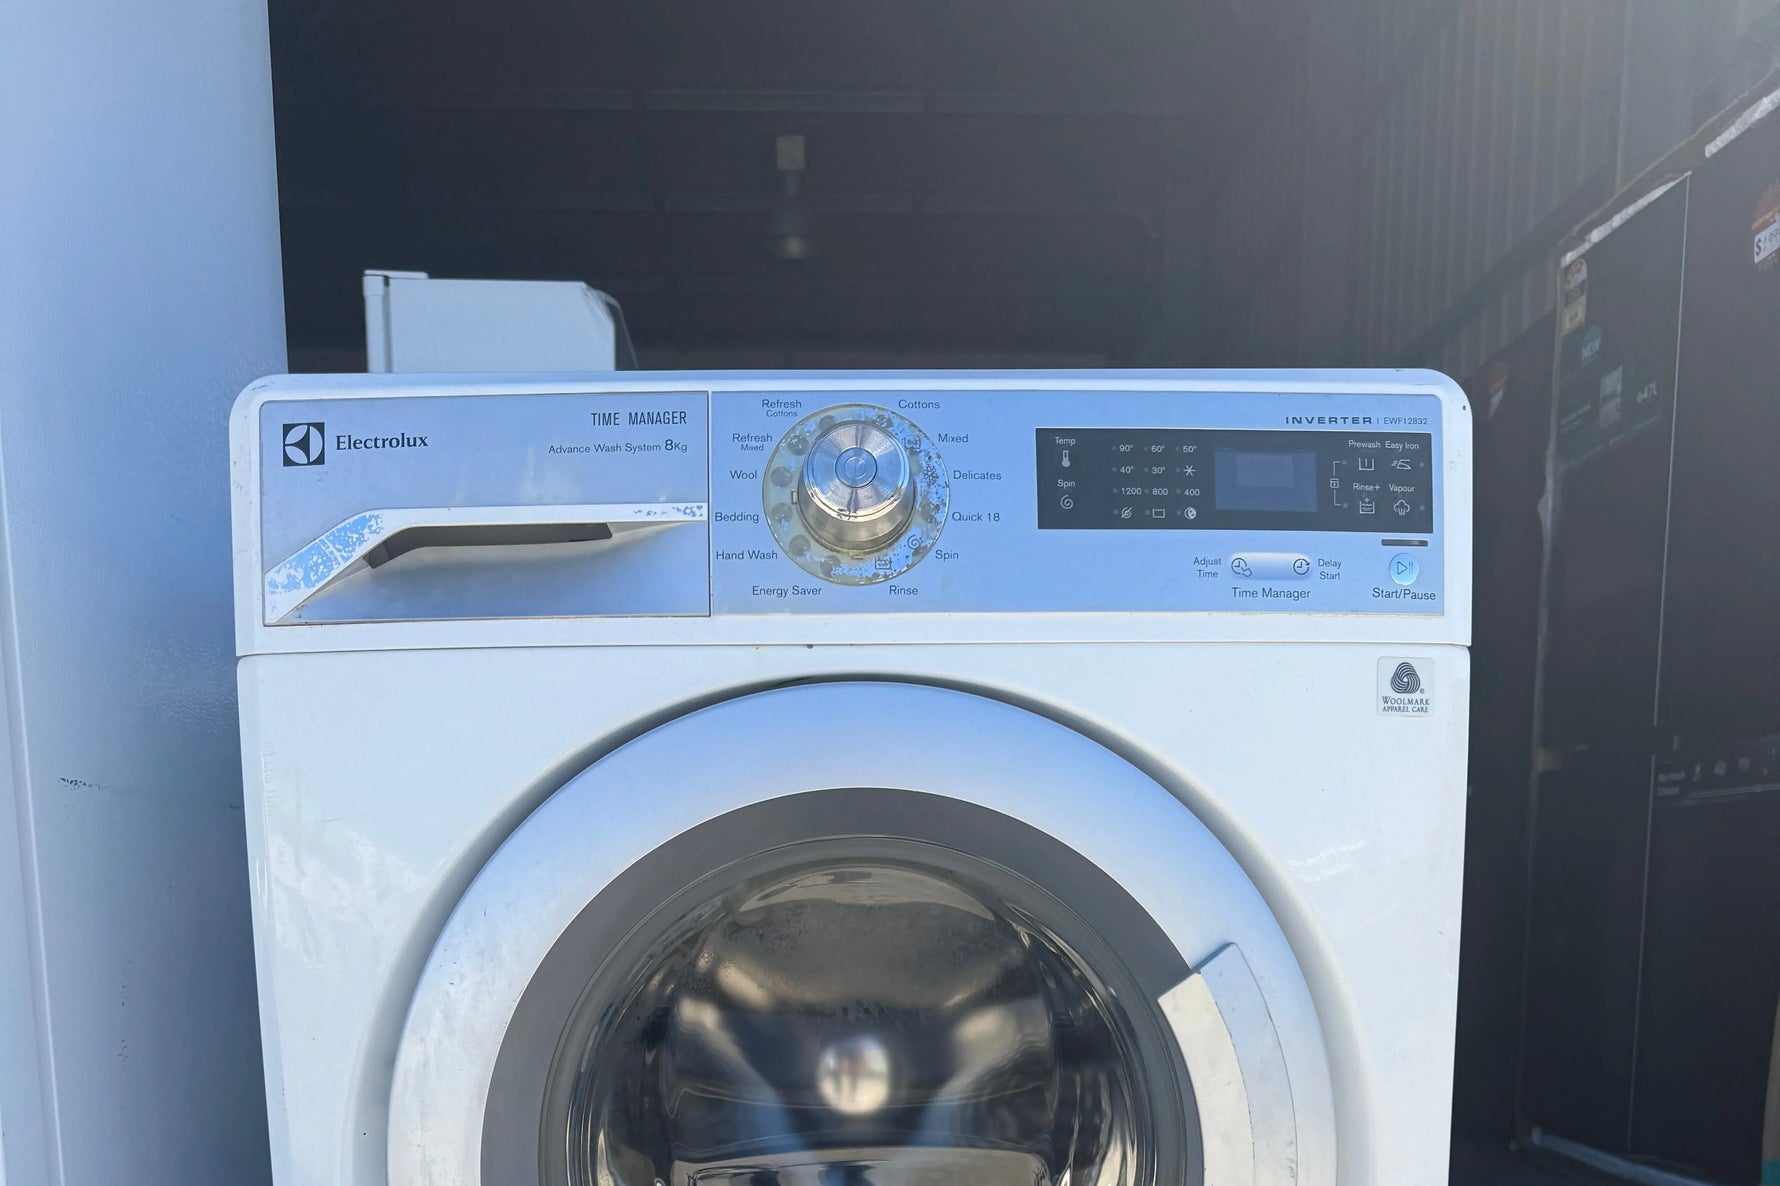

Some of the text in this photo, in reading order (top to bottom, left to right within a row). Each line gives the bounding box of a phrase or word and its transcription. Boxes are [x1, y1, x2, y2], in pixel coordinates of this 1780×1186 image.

[762, 399, 802, 409] Refresh
[898, 399, 940, 409] Cottons
[766, 409, 798, 417] Cottons
[591, 411, 687, 426] TIME MANAGER
[1285, 416, 1372, 425] INVERTER
[336, 433, 429, 451] Electrolux
[732, 433, 773, 443] Refresh
[938, 433, 969, 443] Mixed
[1055, 436, 1076, 446] Temp
[549, 439, 688, 454] Advance Wash System 8Kg
[741, 444, 764, 452] Mixed
[1348, 440, 1381, 449] Prewash
[1385, 441, 1419, 451] Easy Iron
[730, 470, 758, 480] Wool
[953, 470, 1002, 480] Delicates
[1057, 479, 1076, 489] Spin
[1353, 482, 1380, 491] Rinse+
[1388, 483, 1415, 493] Vapour
[1121, 487, 1142, 495] 1200
[1152, 487, 1169, 496] 800
[1184, 488, 1200, 496] 400
[715, 512, 759, 524] Bedding
[952, 511, 1000, 522] Quick 18
[716, 549, 778, 560] Hand Wash
[935, 549, 959, 562] Spin
[1193, 557, 1222, 567] Adjust
[1317, 558, 1342, 570] Delay
[1197, 569, 1218, 579] Time
[1319, 571, 1341, 581] Start
[752, 585, 823, 598] Energy Saver
[889, 585, 918, 595] Rinse
[1232, 587, 1311, 601] Time Manager
[1372, 587, 1436, 601] Start/Pause
[1382, 695, 1430, 706] WOOLMARK
[1382, 705, 1410, 713] APPAREL
